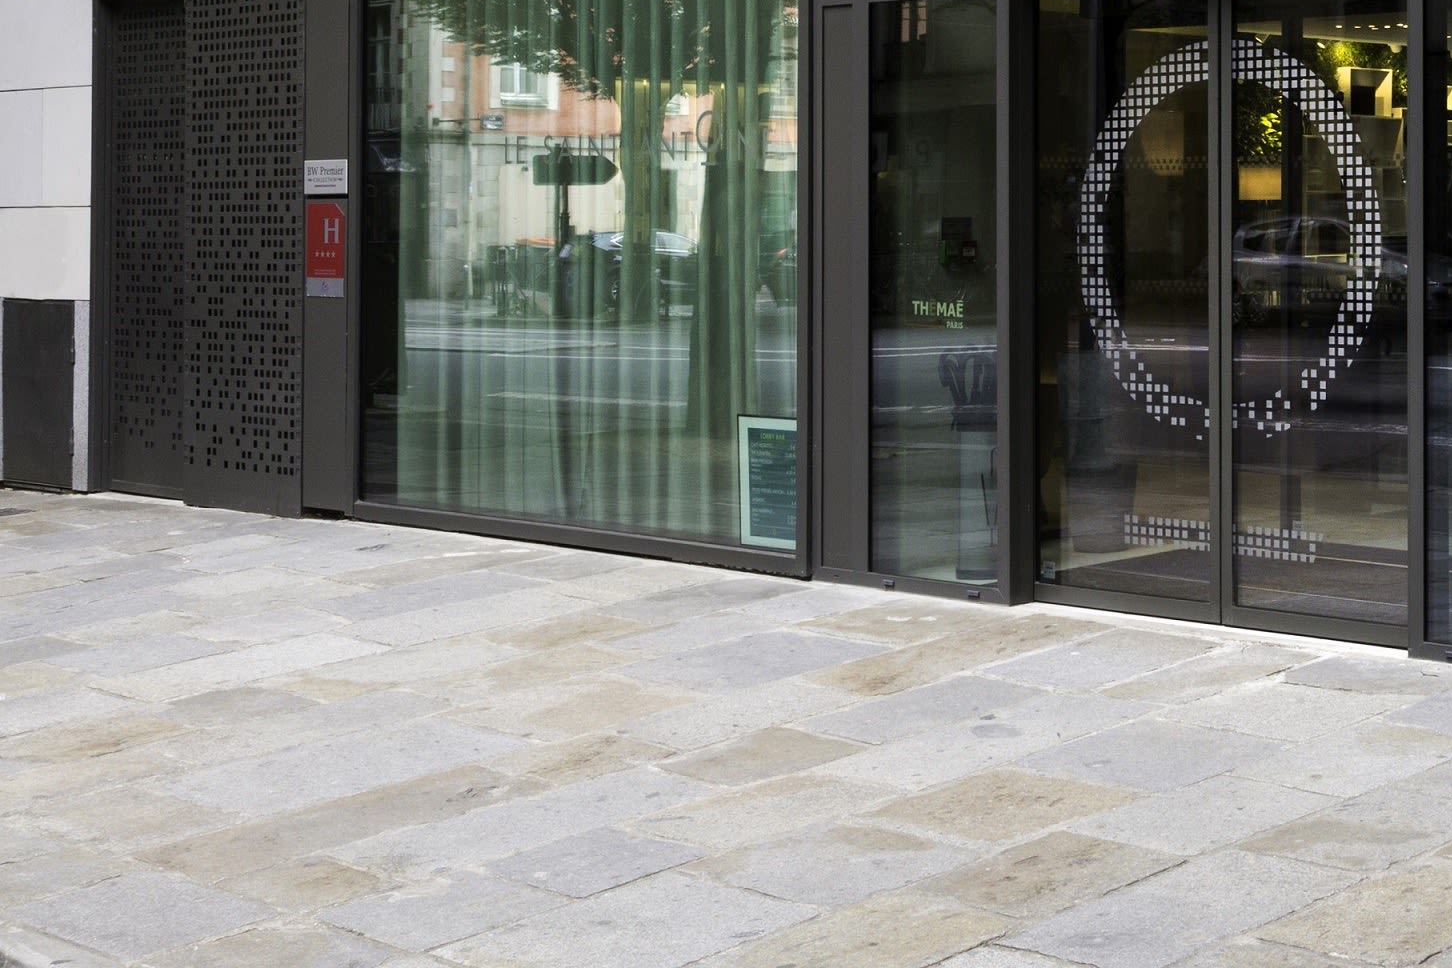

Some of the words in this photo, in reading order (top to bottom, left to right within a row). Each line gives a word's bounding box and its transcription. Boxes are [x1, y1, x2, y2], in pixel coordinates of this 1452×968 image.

[504, 136, 527, 164] LE
[544, 133, 622, 164] SAINT
[320, 166, 344, 176] Premier
[322, 218, 341, 244] H
[946, 321, 964, 329] PARIS
